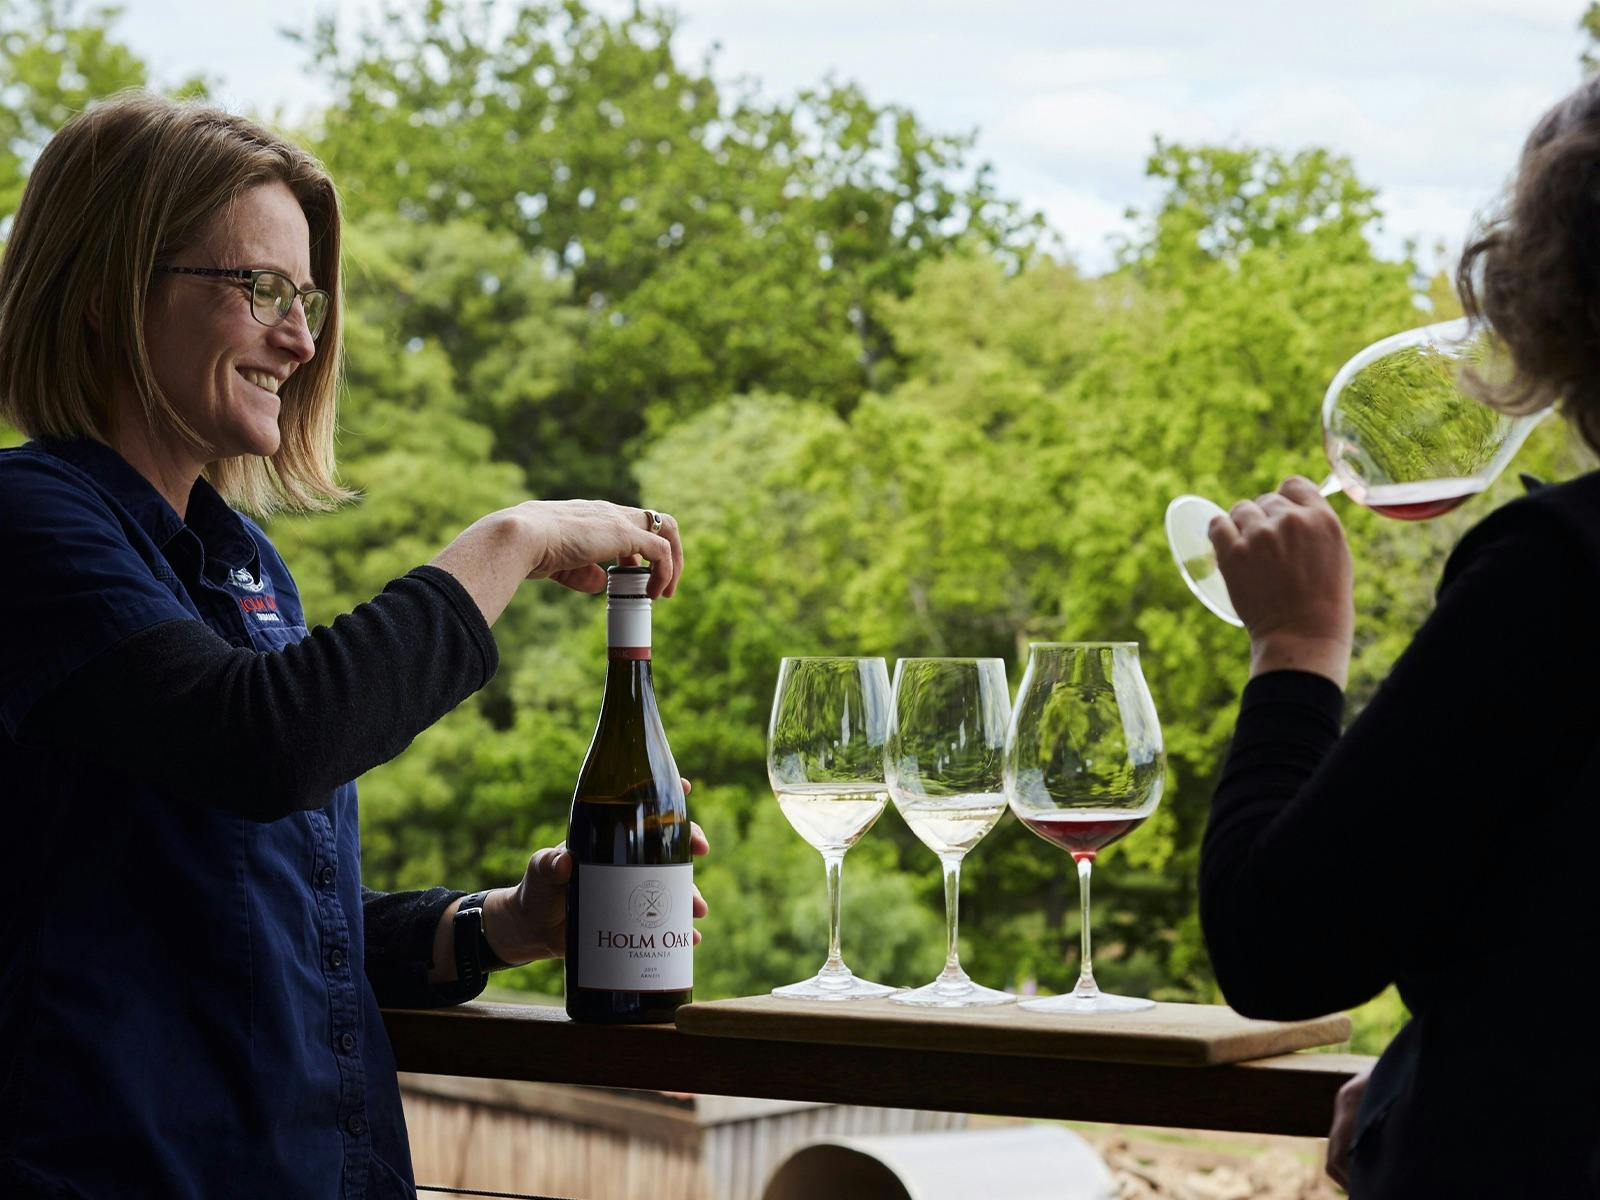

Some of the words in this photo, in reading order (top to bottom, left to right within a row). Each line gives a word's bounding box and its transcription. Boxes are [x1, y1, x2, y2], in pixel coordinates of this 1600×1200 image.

[597, 930, 655, 949] HOLM
[662, 931, 690, 948] OAK
[628, 951, 671, 959] TASMANIA
